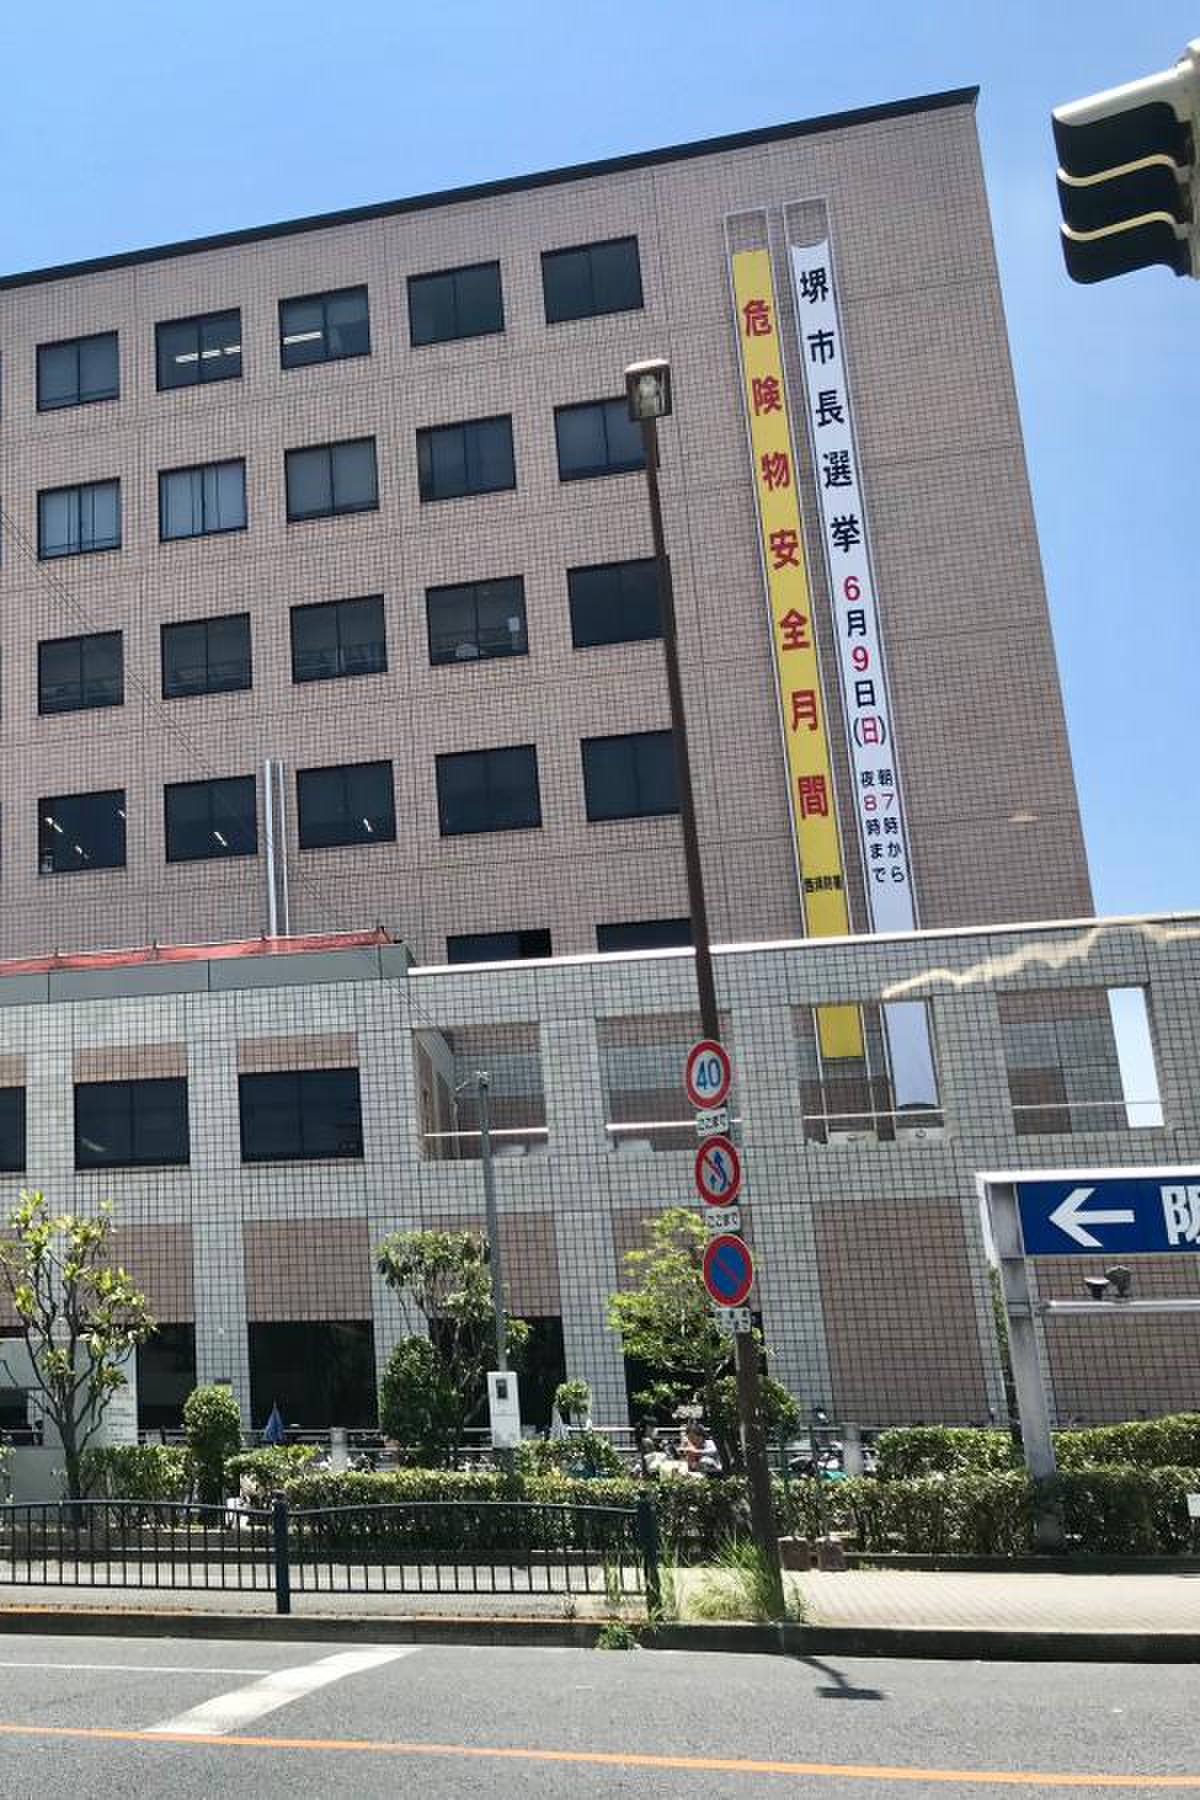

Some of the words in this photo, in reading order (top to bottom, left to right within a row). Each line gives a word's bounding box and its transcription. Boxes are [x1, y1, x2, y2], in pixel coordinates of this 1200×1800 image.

[742, 299, 829, 820] 危険物安全月間
[696, 1058, 721, 1091] 40
